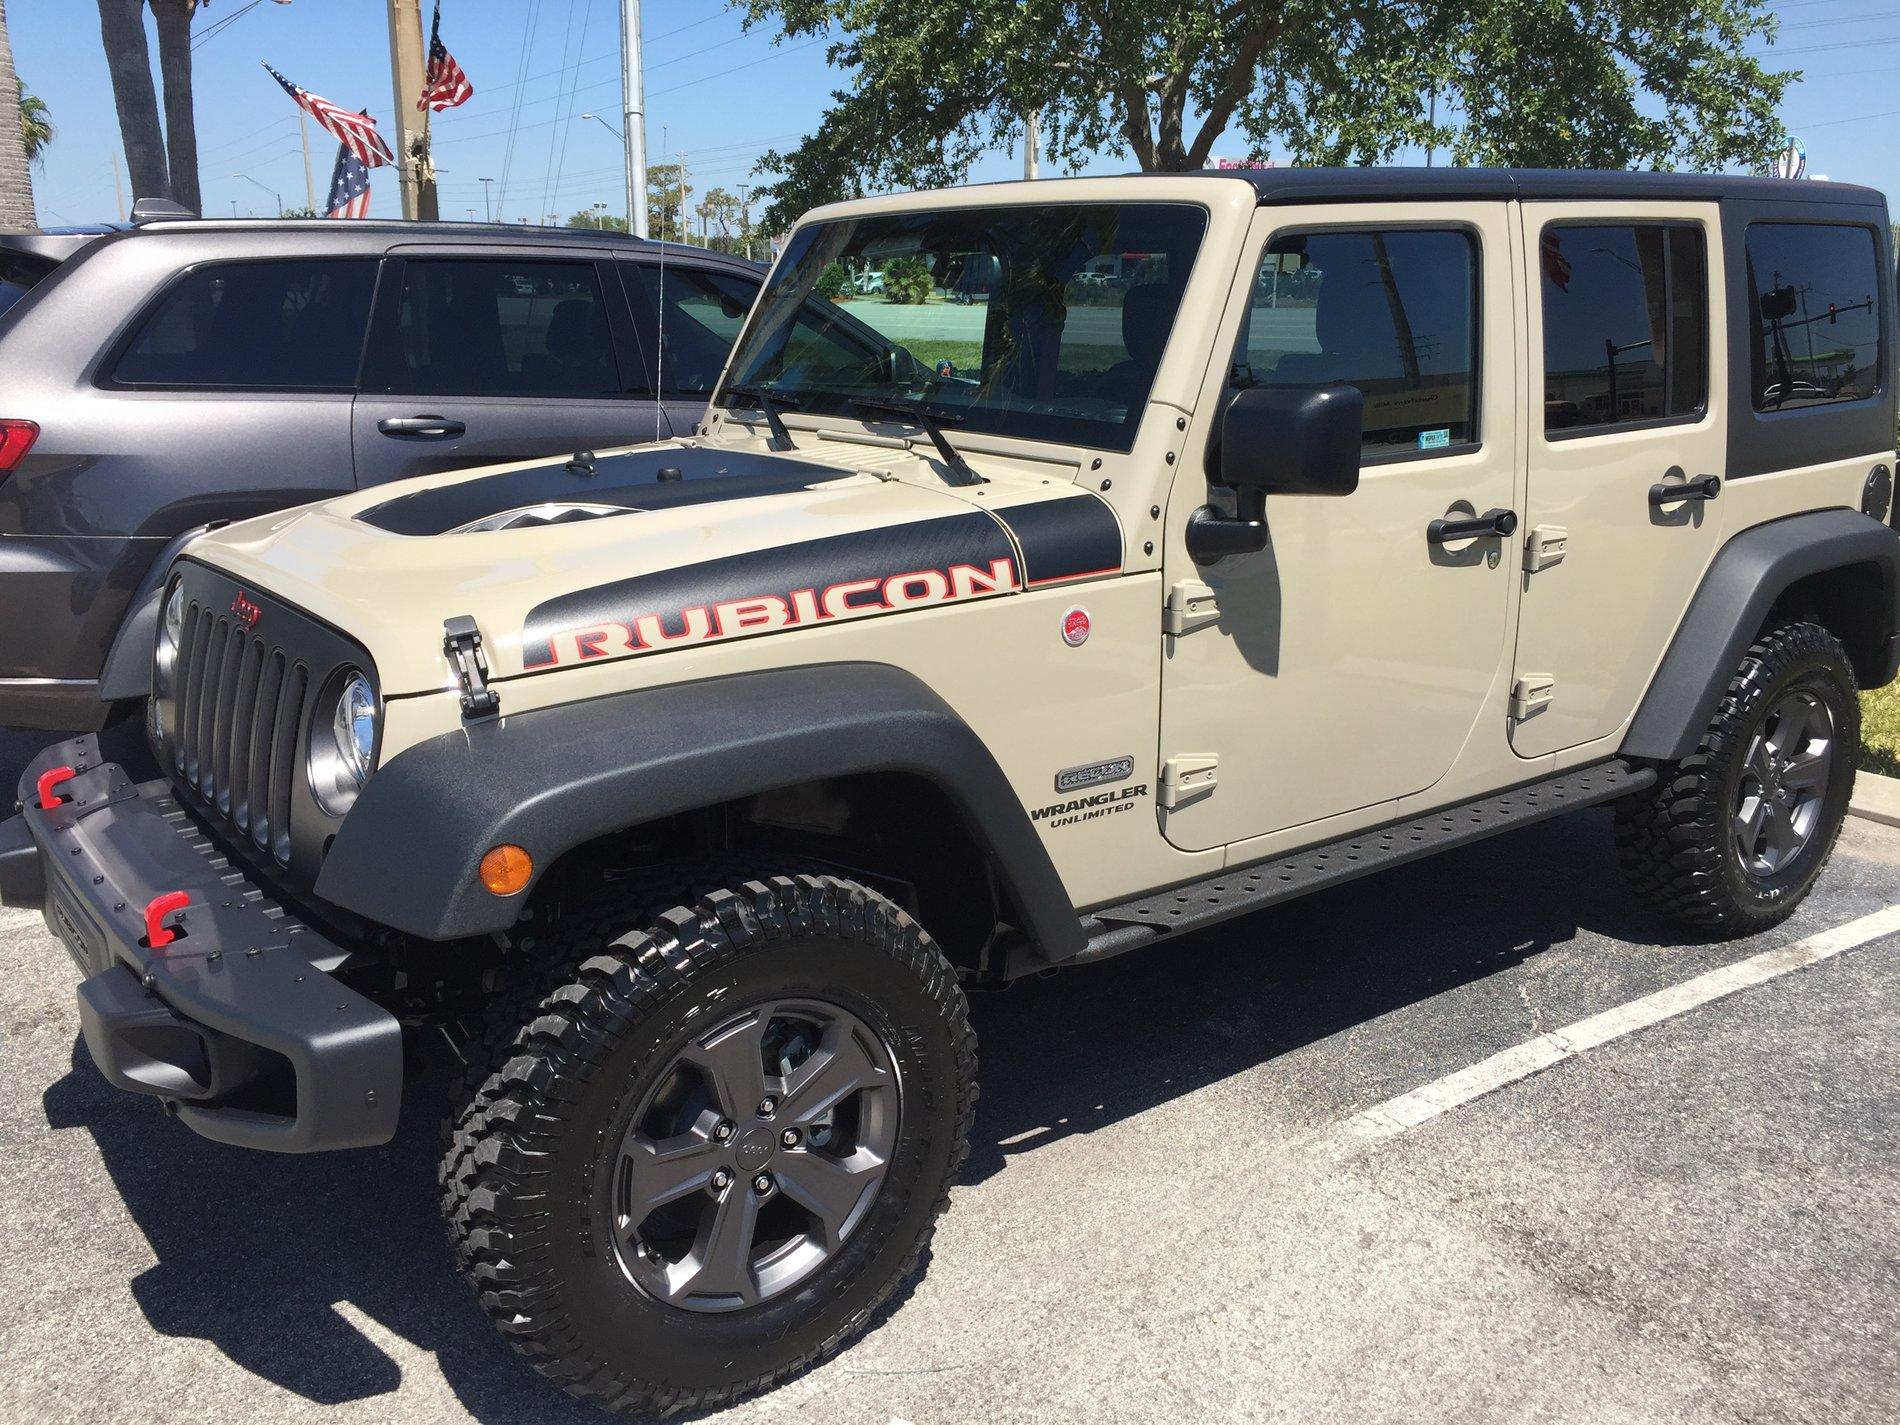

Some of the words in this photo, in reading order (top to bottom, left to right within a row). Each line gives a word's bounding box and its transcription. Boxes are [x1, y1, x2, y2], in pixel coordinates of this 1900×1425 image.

[547, 558, 1020, 664] RUBICON
[1030, 783, 1148, 821] WRANGLER
[1050, 802, 1135, 828] UNLIMITED
